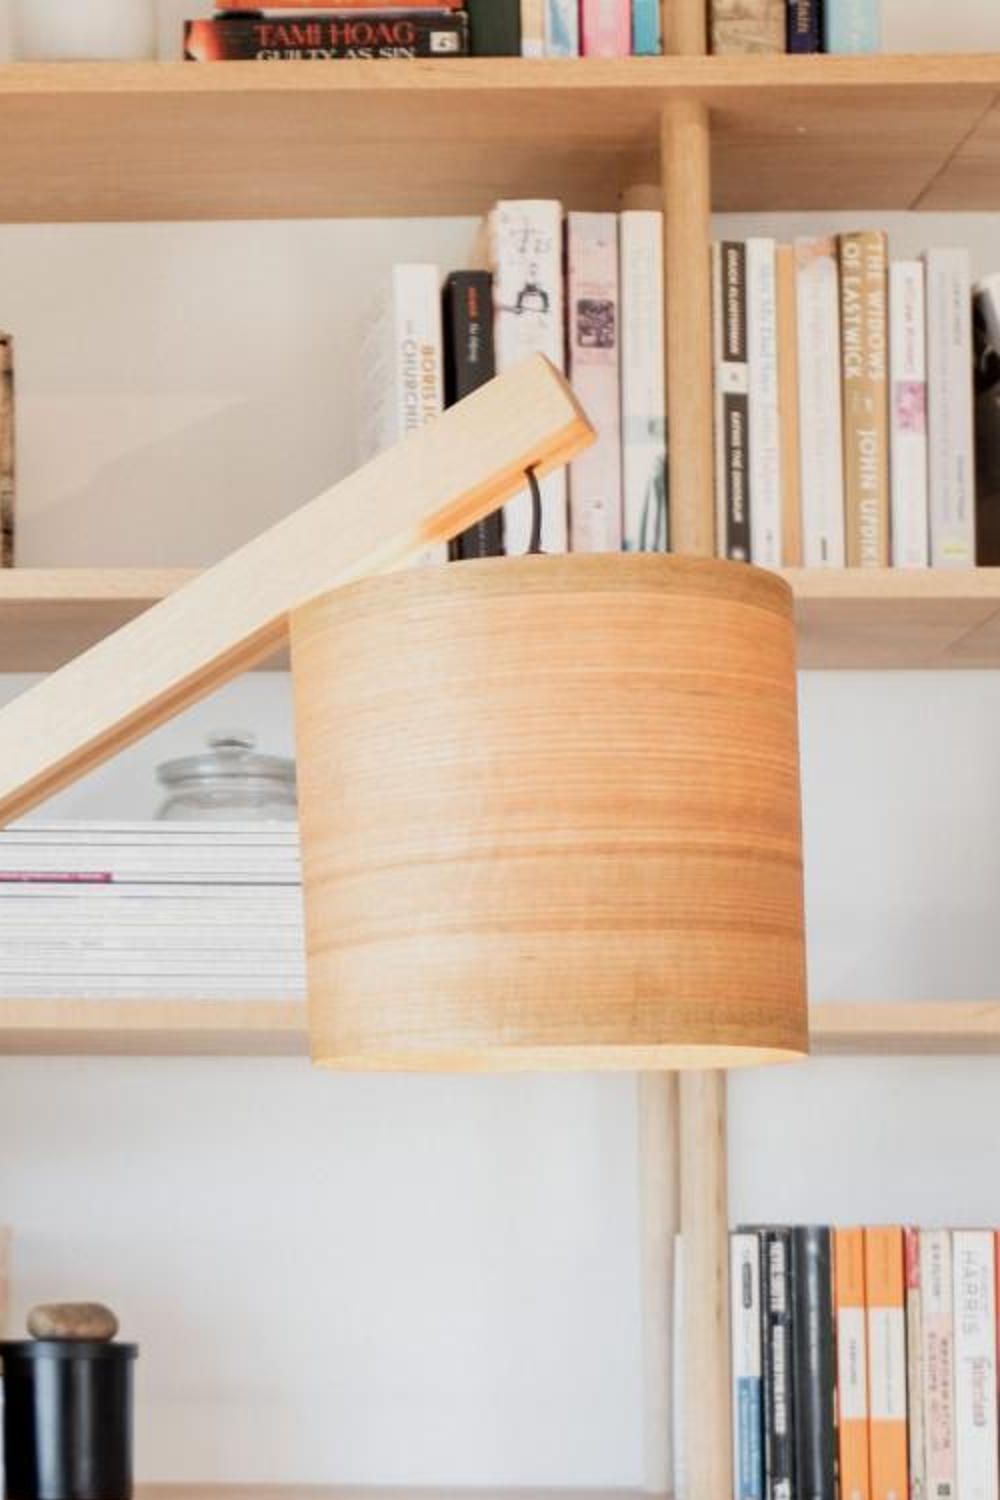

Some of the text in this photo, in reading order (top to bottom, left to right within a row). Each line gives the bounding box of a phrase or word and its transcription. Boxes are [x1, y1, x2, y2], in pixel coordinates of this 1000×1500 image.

[254, 20, 416, 46] TAMI HOAG
[256, 48, 336, 61] GUILTY
[343, 48, 374, 59] AS
[842, 242, 862, 379] OF EASTWICK
[866, 244, 885, 383] THE WIDOWS
[856, 430, 878, 489] JOHN
[961, 1250, 980, 1334] HARRIS
